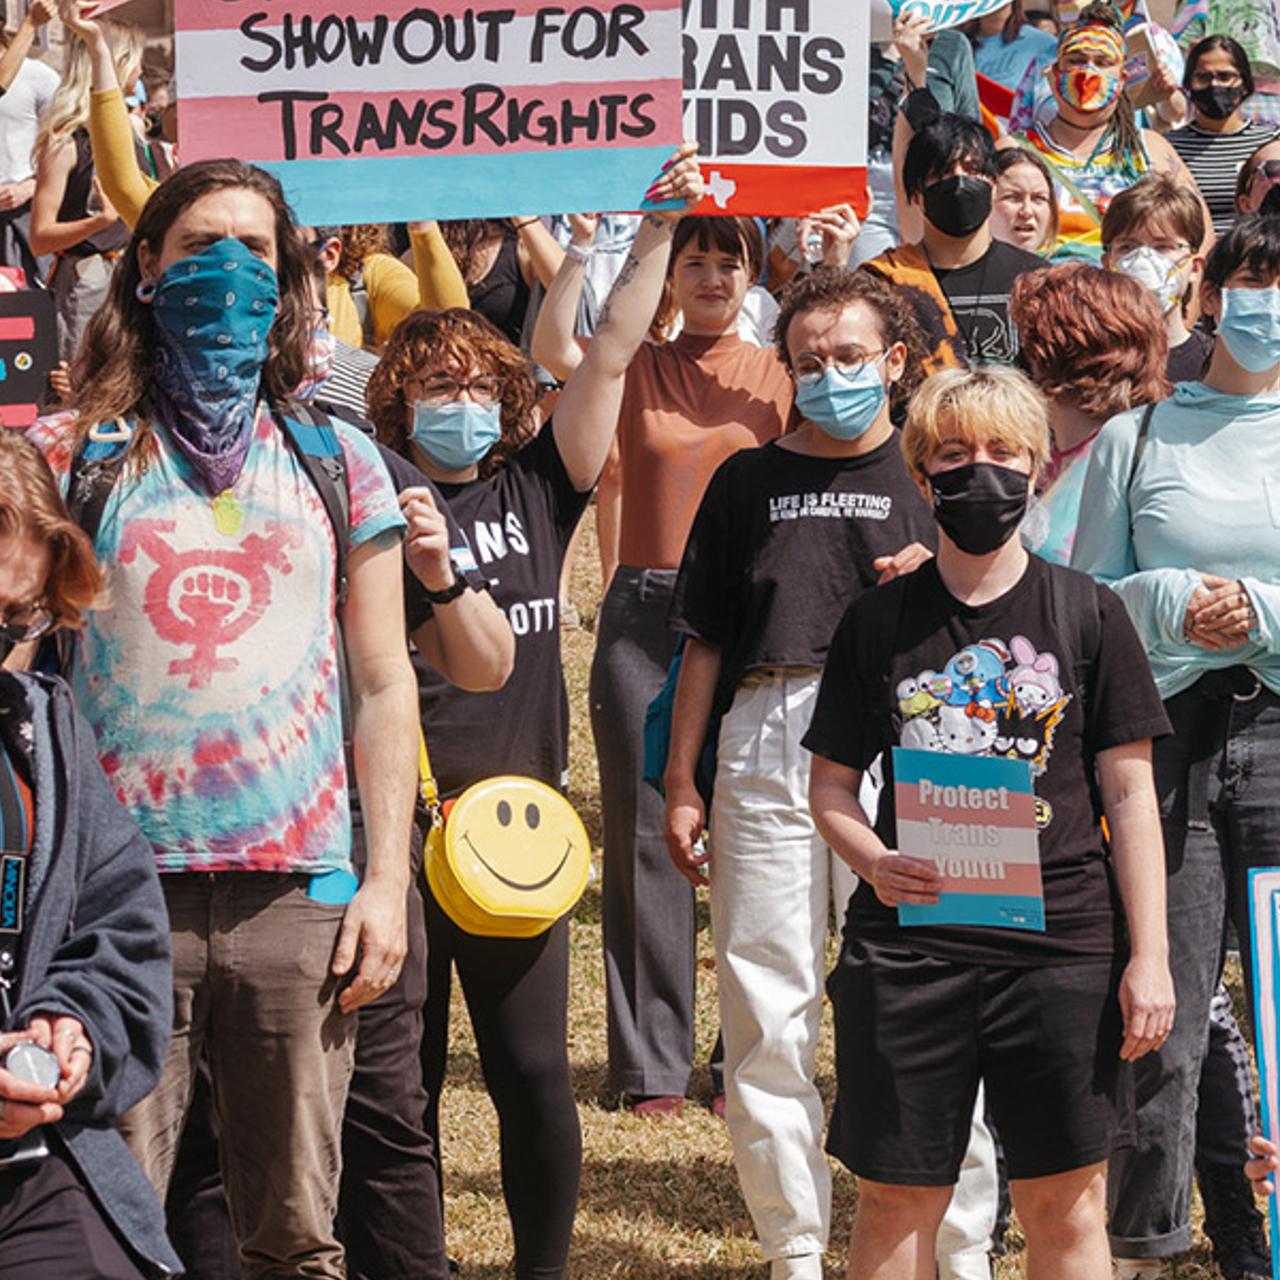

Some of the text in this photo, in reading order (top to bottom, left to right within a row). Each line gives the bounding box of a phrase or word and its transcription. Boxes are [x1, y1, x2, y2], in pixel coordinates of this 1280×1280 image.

[530, 3, 650, 63] FOR
[682, 98, 808, 158] IDS
[769, 492, 892, 511] LIFE IS FLEETING
[919, 778, 1009, 810] Protect
[928, 817, 1000, 846] Trans
[934, 855, 1006, 880] Youth
